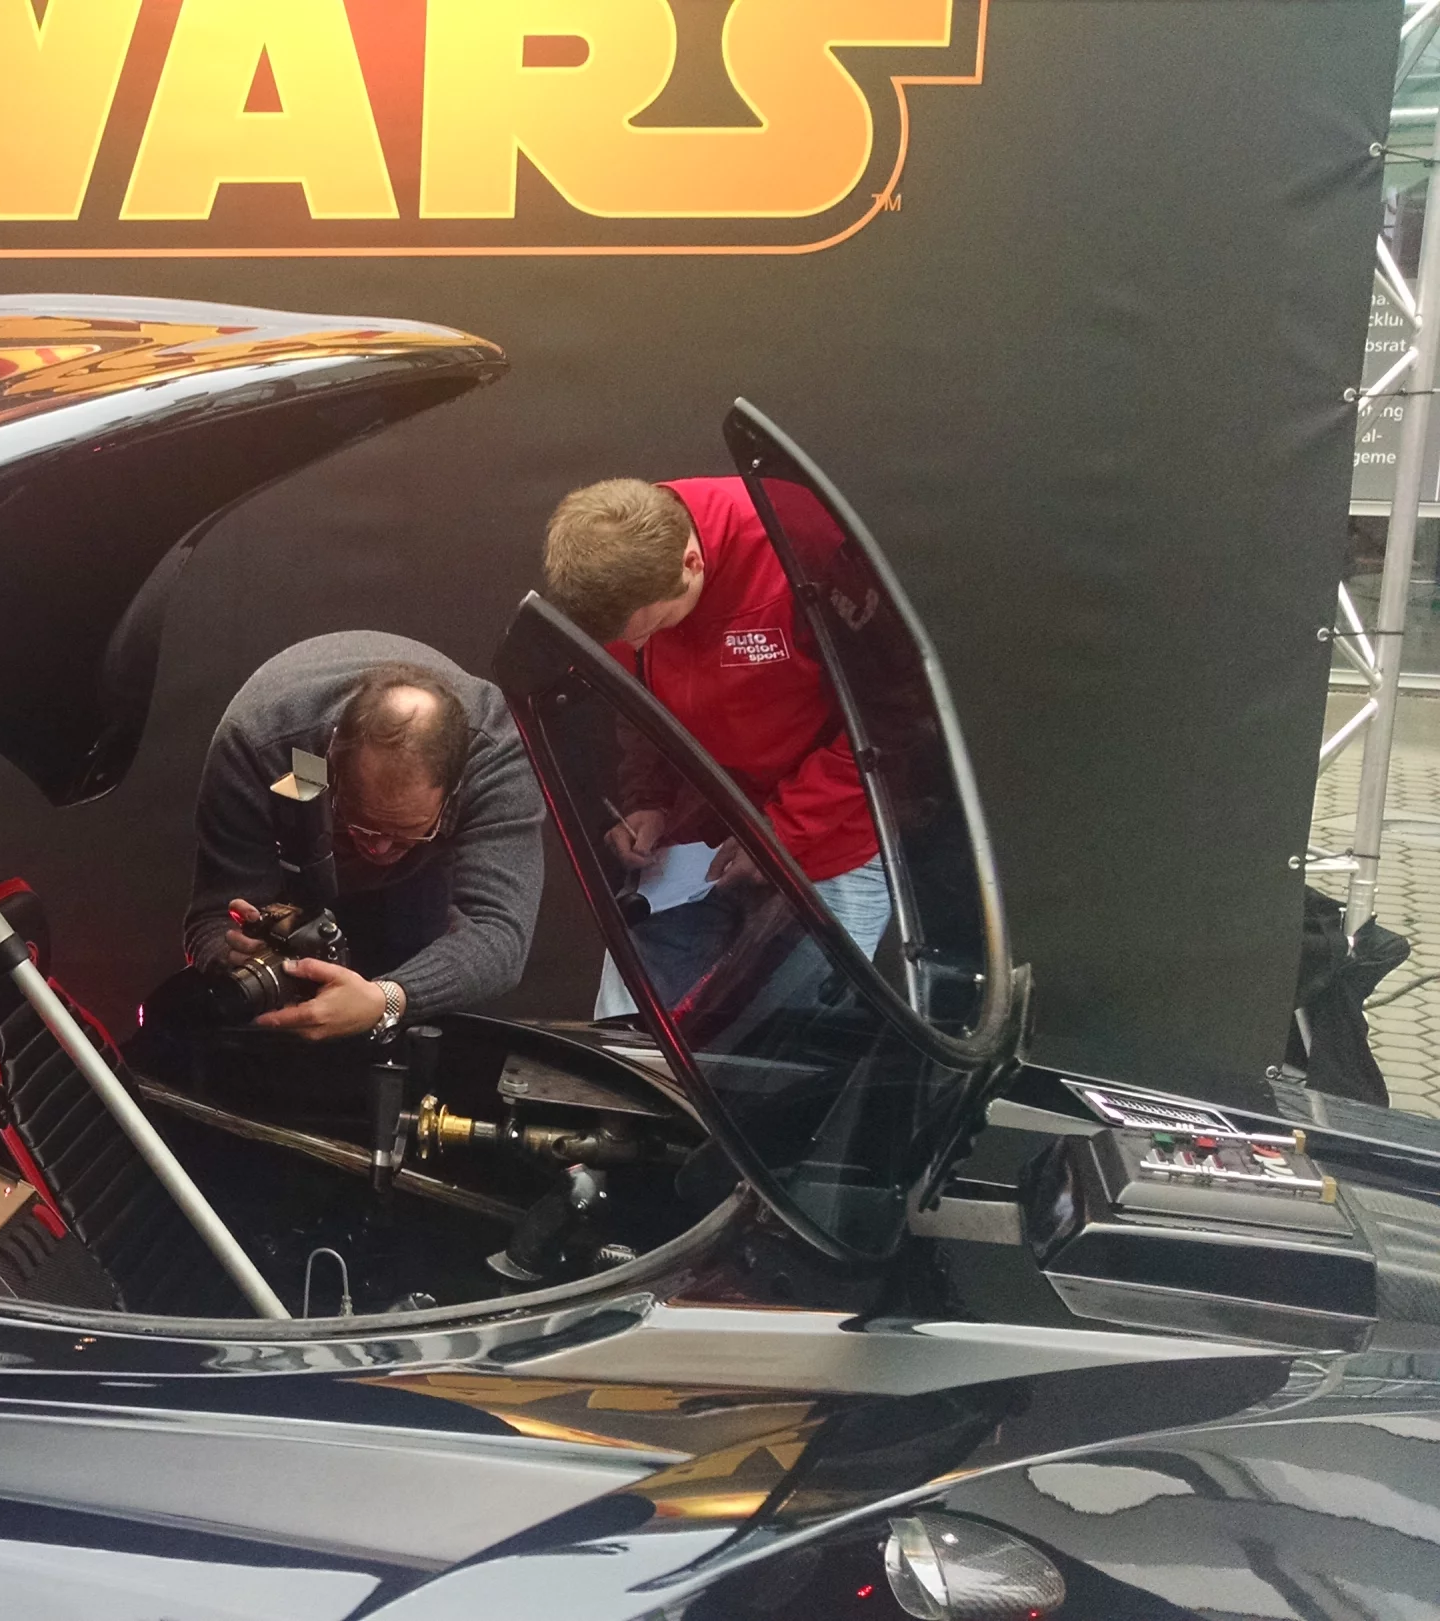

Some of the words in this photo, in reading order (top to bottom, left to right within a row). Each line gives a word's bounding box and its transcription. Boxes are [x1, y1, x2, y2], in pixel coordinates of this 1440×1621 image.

[725, 633, 767, 646] auto
[733, 643, 778, 655] motor
[748, 650, 785, 662] sport
